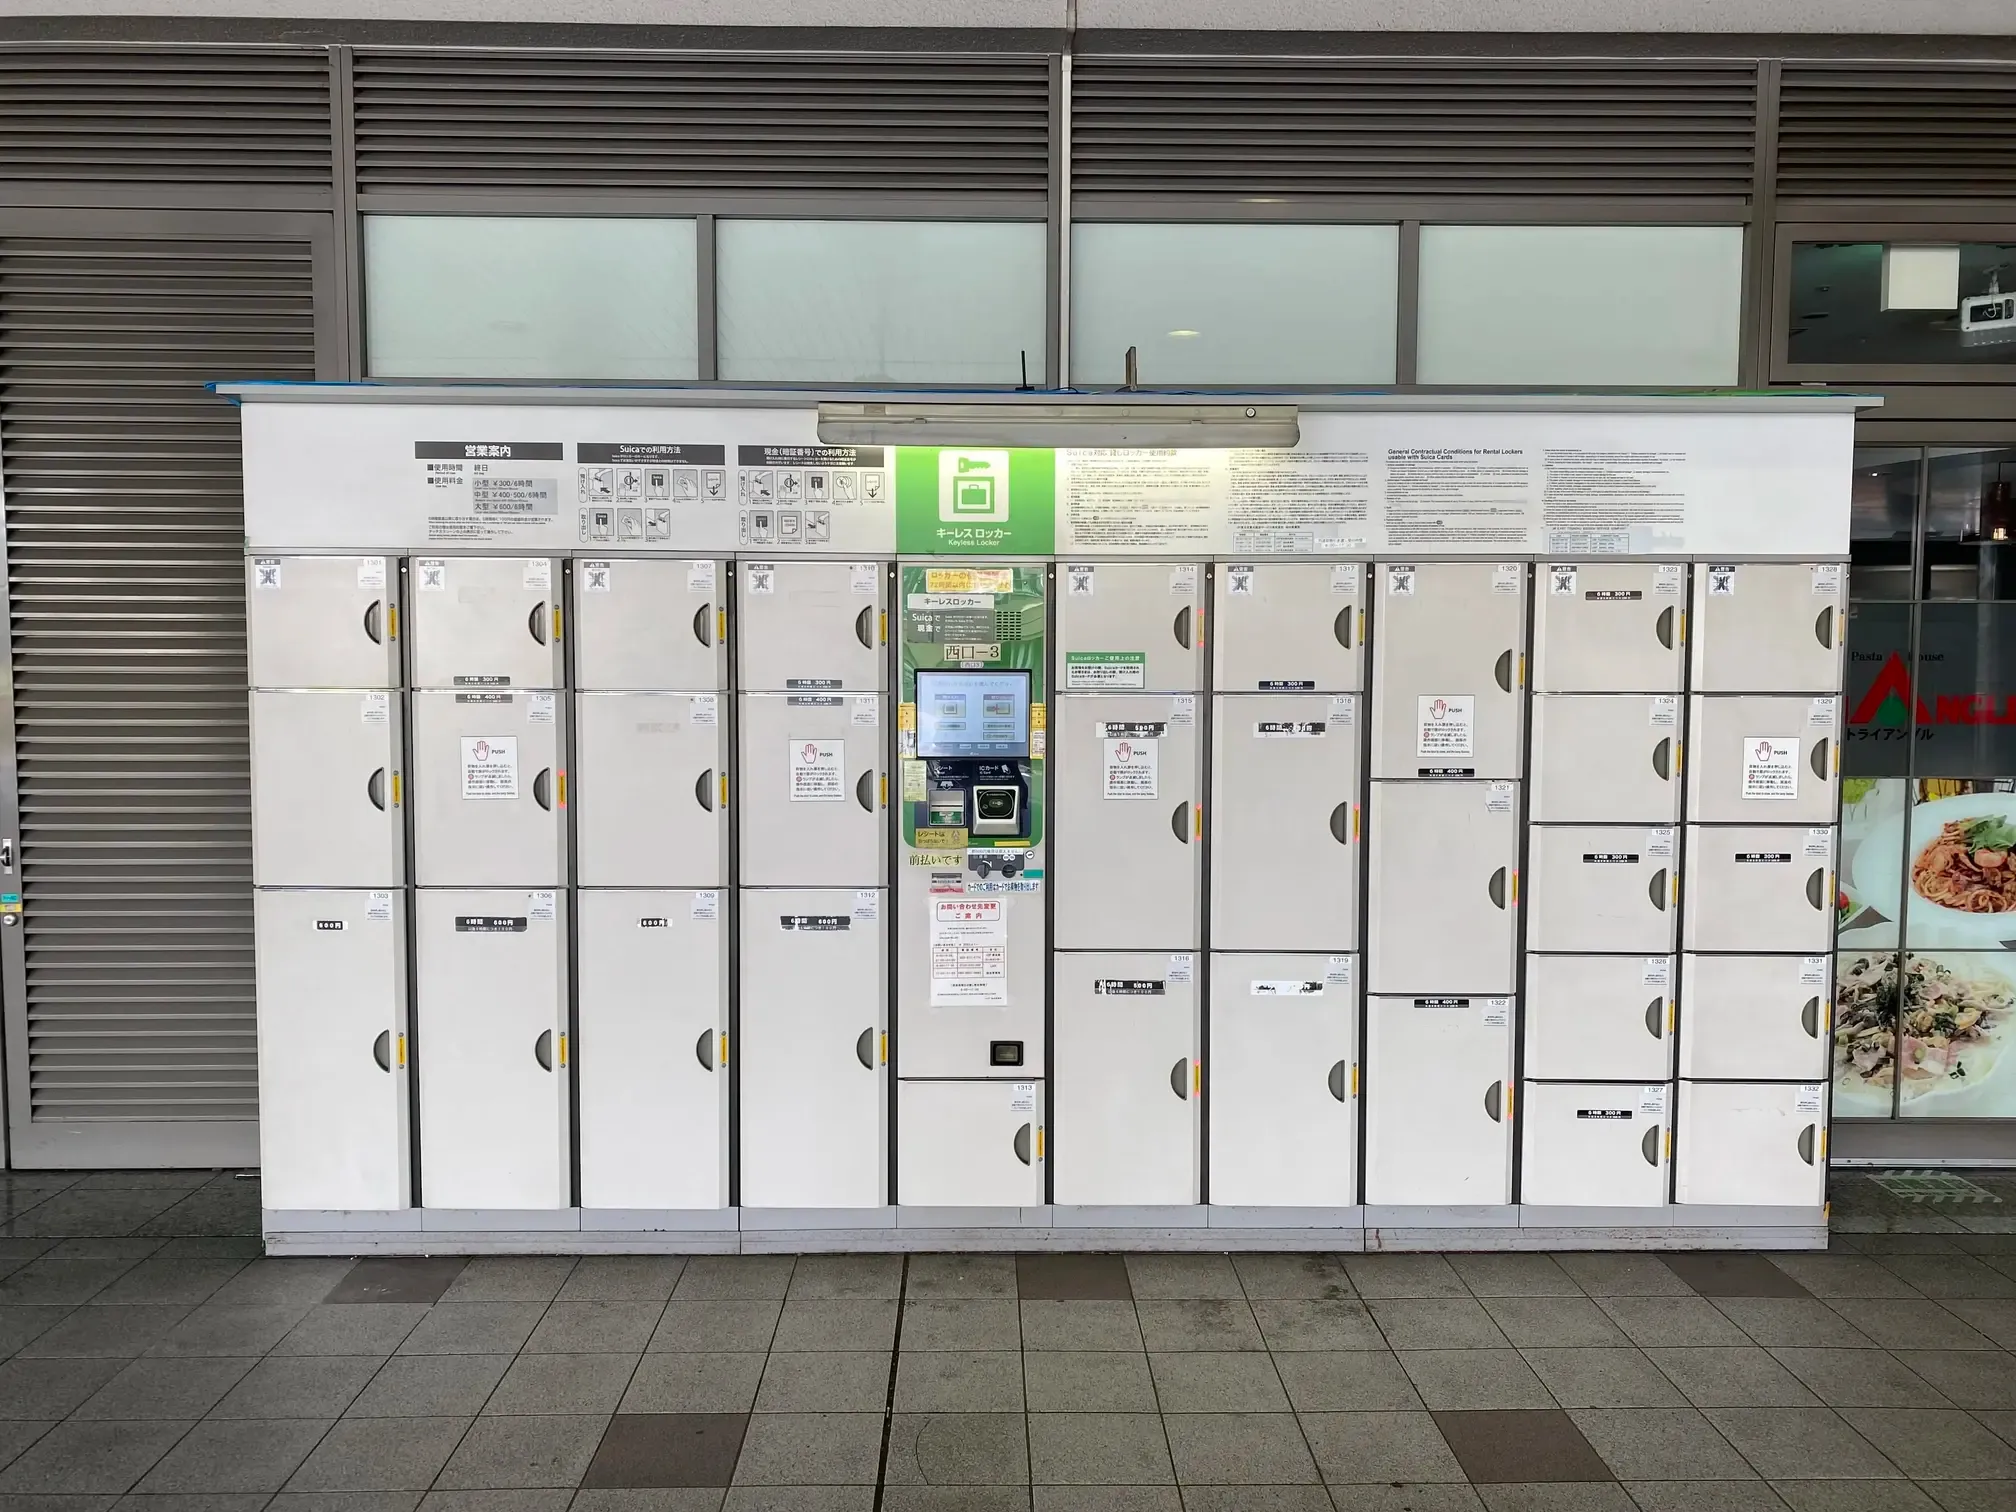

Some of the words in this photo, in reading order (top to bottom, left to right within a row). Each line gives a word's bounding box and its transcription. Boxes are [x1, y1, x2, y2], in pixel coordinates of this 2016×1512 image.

[464, 444, 512, 457] 営業案内
[619, 445, 682, 454] Suicaでの利用方法
[434, 477, 464, 485] 使用料金
[935, 528, 973, 539] キーレス
[975, 528, 1013, 539] ロッカー
[948, 539, 975, 547] Keyless
[923, 597, 982, 606] キーレスロッカー
[1851, 651, 1883, 662] Pasta
[1908, 651, 1945, 662] ouse
[1846, 728, 1934, 742] トライアンル
[908, 854, 963, 866] 前払いです
[940, 903, 998, 911] お問い合わせ先変更
